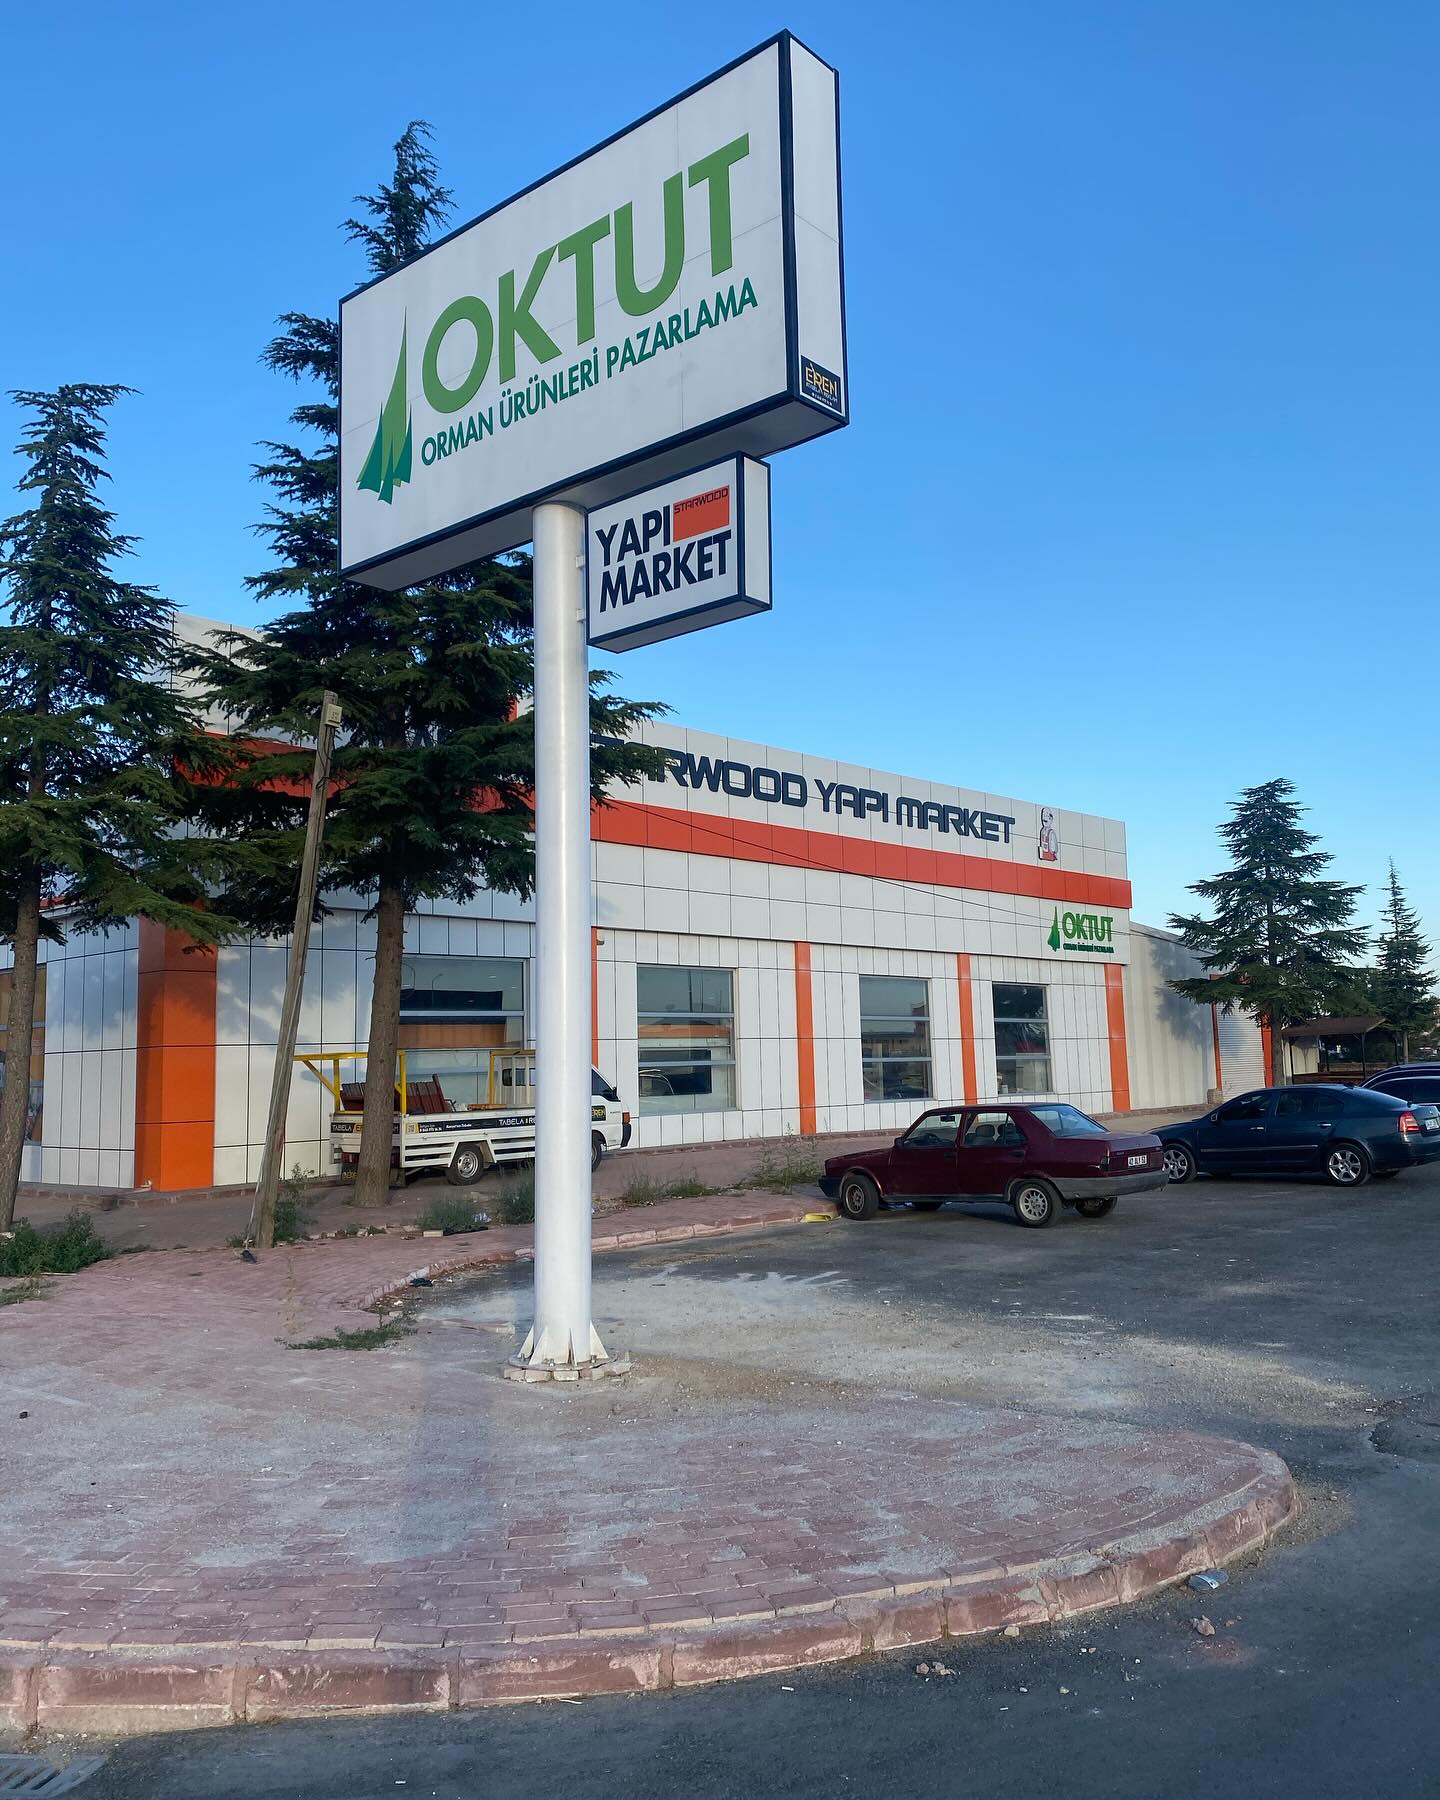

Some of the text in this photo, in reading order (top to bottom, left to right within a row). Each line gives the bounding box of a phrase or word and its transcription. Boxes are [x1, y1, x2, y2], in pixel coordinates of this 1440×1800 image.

[422, 132, 749, 413] OKTUT
[421, 277, 758, 466] ORMAN ÜRÜNLERİ PAZARLAMA
[674, 486, 729, 513] STARWOOD
[595, 504, 671, 567] YAPI
[600, 529, 732, 613] MARKET
[814, 778, 888, 823] YAPI
[896, 796, 1015, 843] MARKET
[1062, 911, 1113, 942] OKTUT
[498, 1117, 525, 1126] TABELA
